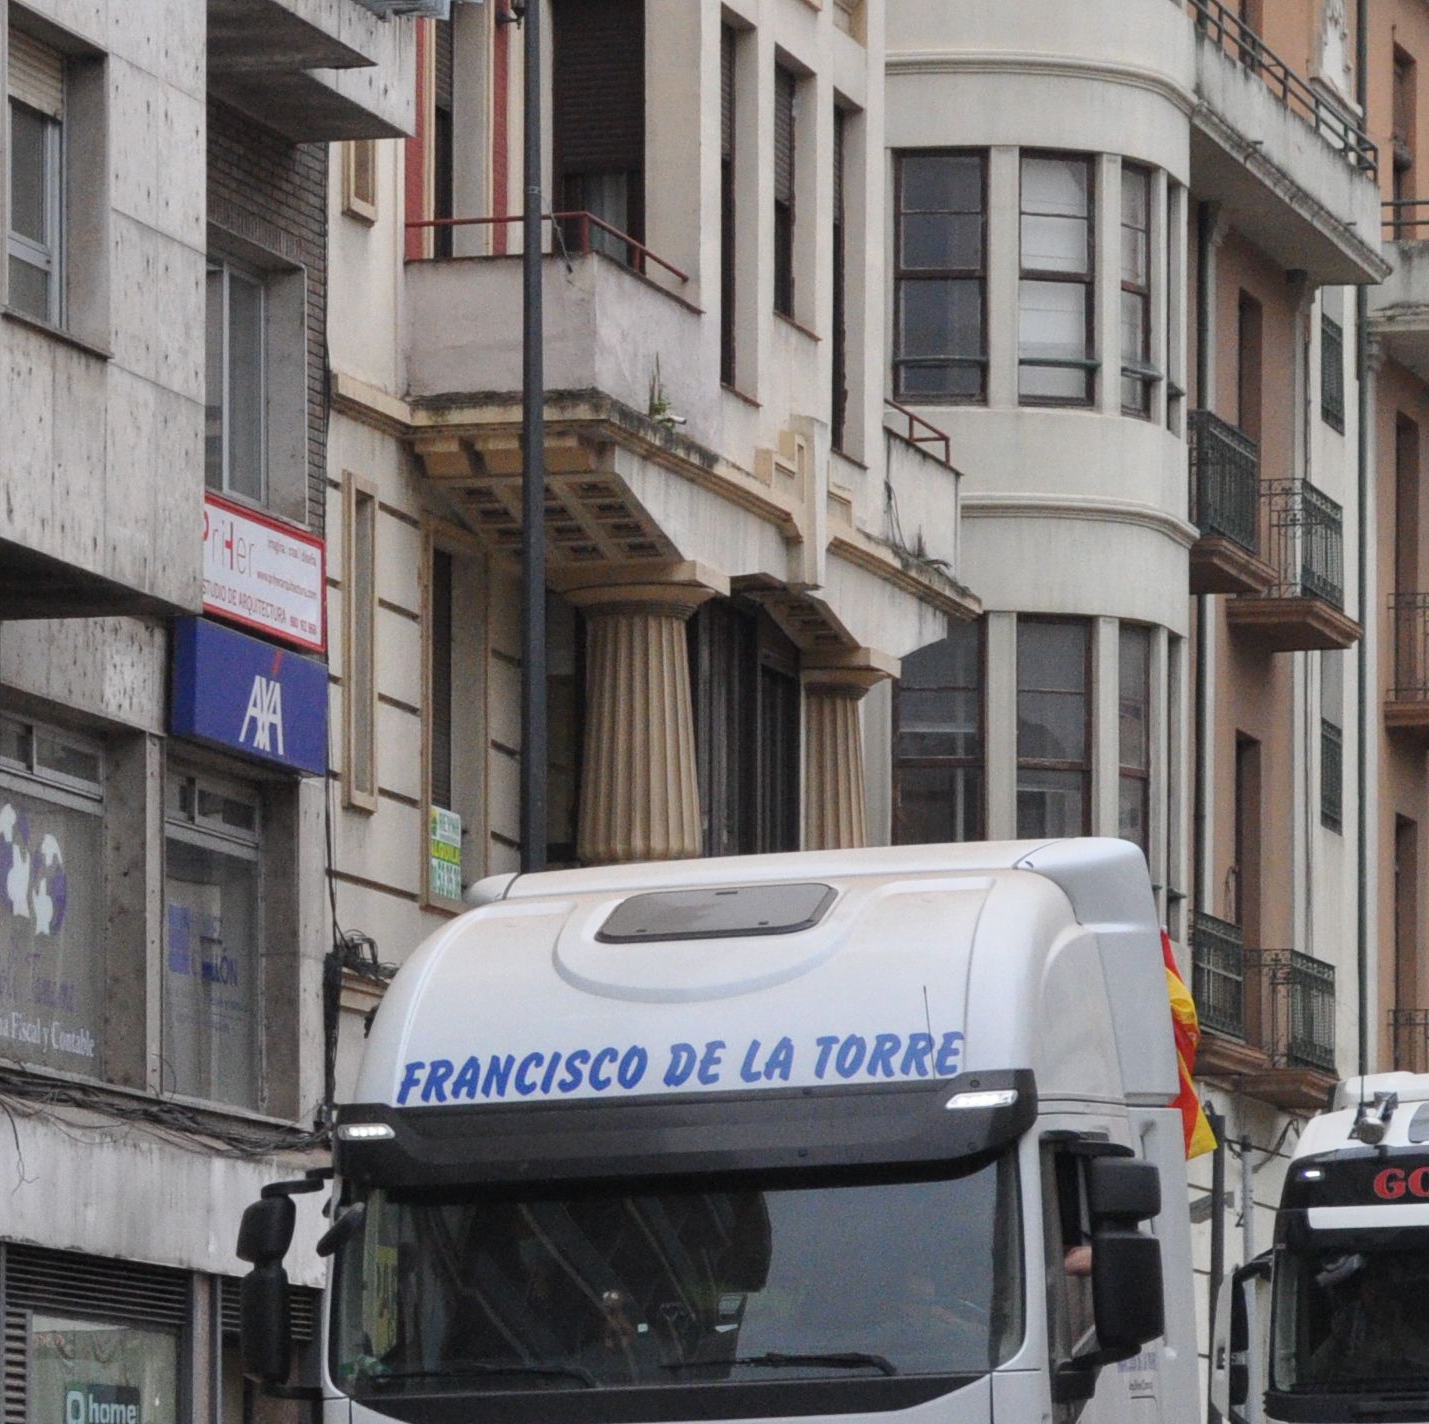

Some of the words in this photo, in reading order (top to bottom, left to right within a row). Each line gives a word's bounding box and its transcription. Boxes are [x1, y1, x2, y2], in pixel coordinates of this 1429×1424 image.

[238, 674, 284, 755] AXA
[395, 1045, 649, 1105] FRANCISCO
[662, 1040, 727, 1088] DE
[740, 1036, 793, 1084] LA
[813, 1030, 965, 1080] TORRE
